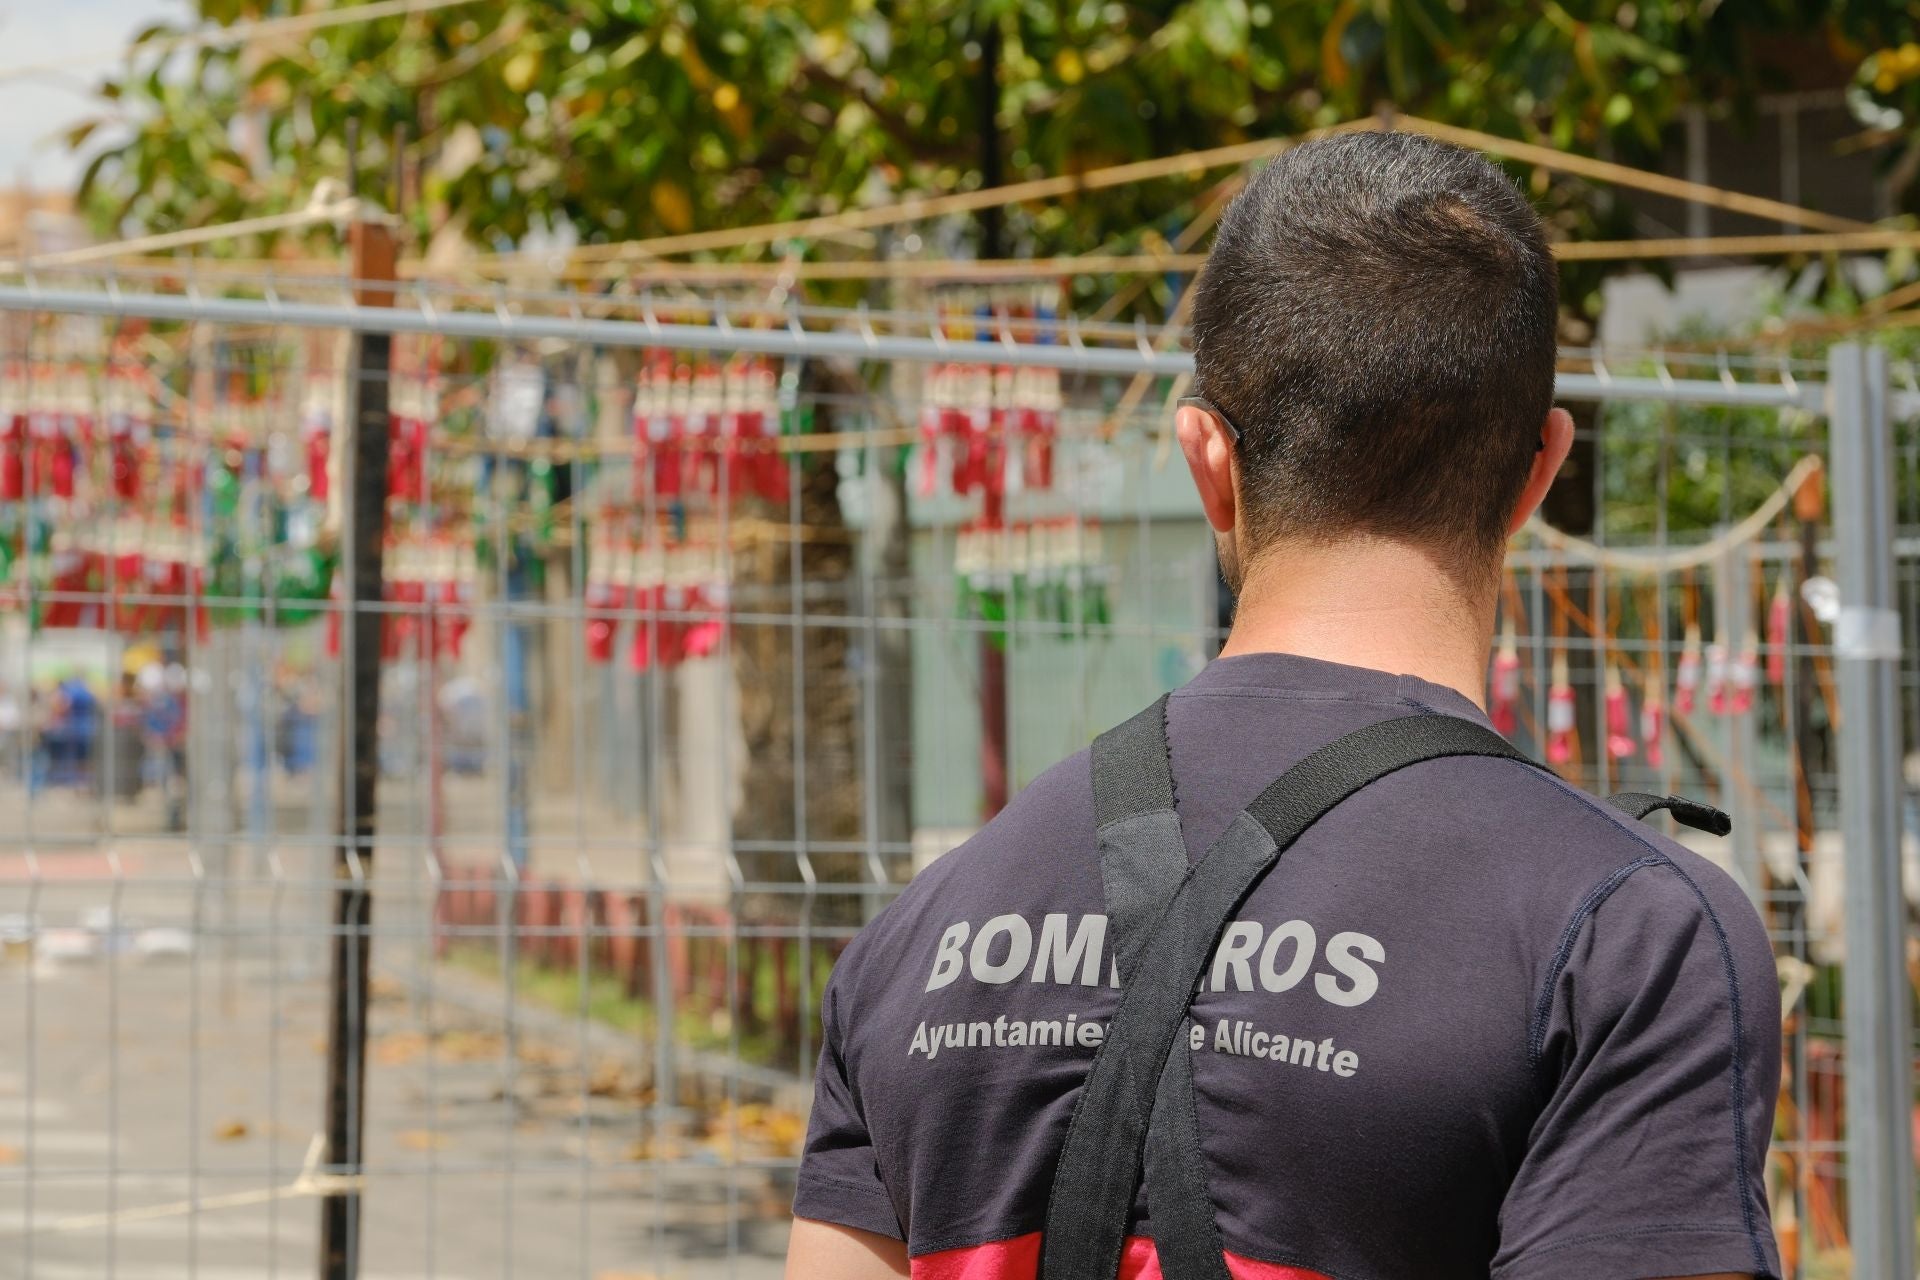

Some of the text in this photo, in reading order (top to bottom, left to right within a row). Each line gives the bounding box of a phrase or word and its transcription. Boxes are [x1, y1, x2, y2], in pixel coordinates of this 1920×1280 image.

[925, 912, 1386, 1007] BOMROS
[907, 1014, 1360, 1078] Ayuntamie e Alicante
